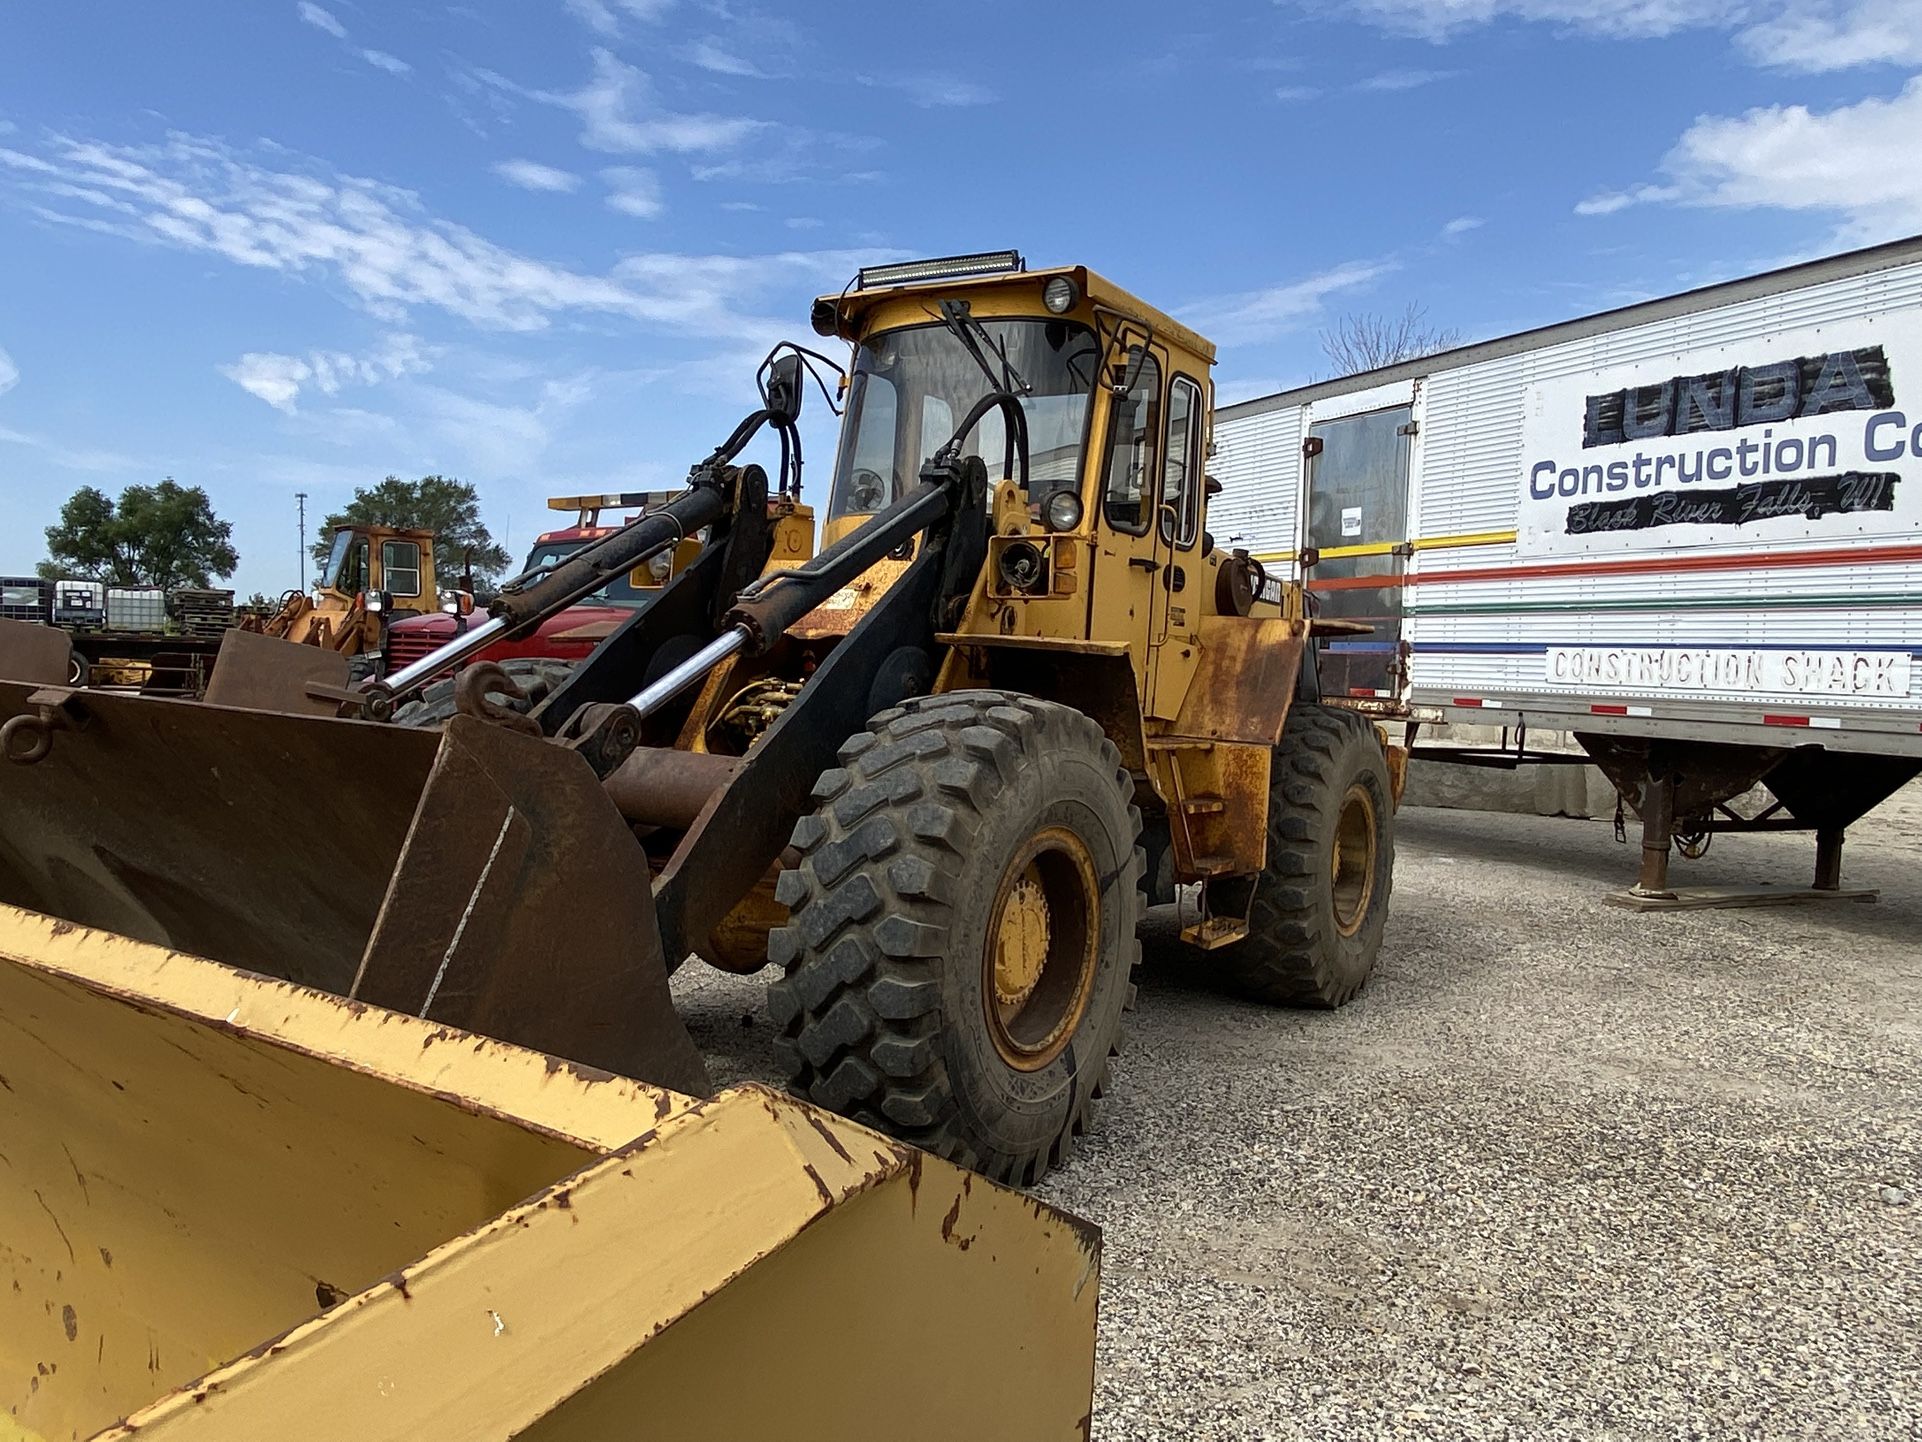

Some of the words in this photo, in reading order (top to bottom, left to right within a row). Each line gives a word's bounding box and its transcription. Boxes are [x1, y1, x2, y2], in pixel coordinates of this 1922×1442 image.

[1529, 428, 1837, 501] Construction
[1650, 492, 1724, 526] River
[1554, 651, 1763, 687] CONSTRUCTION
[1782, 656, 1896, 693] SHACK
